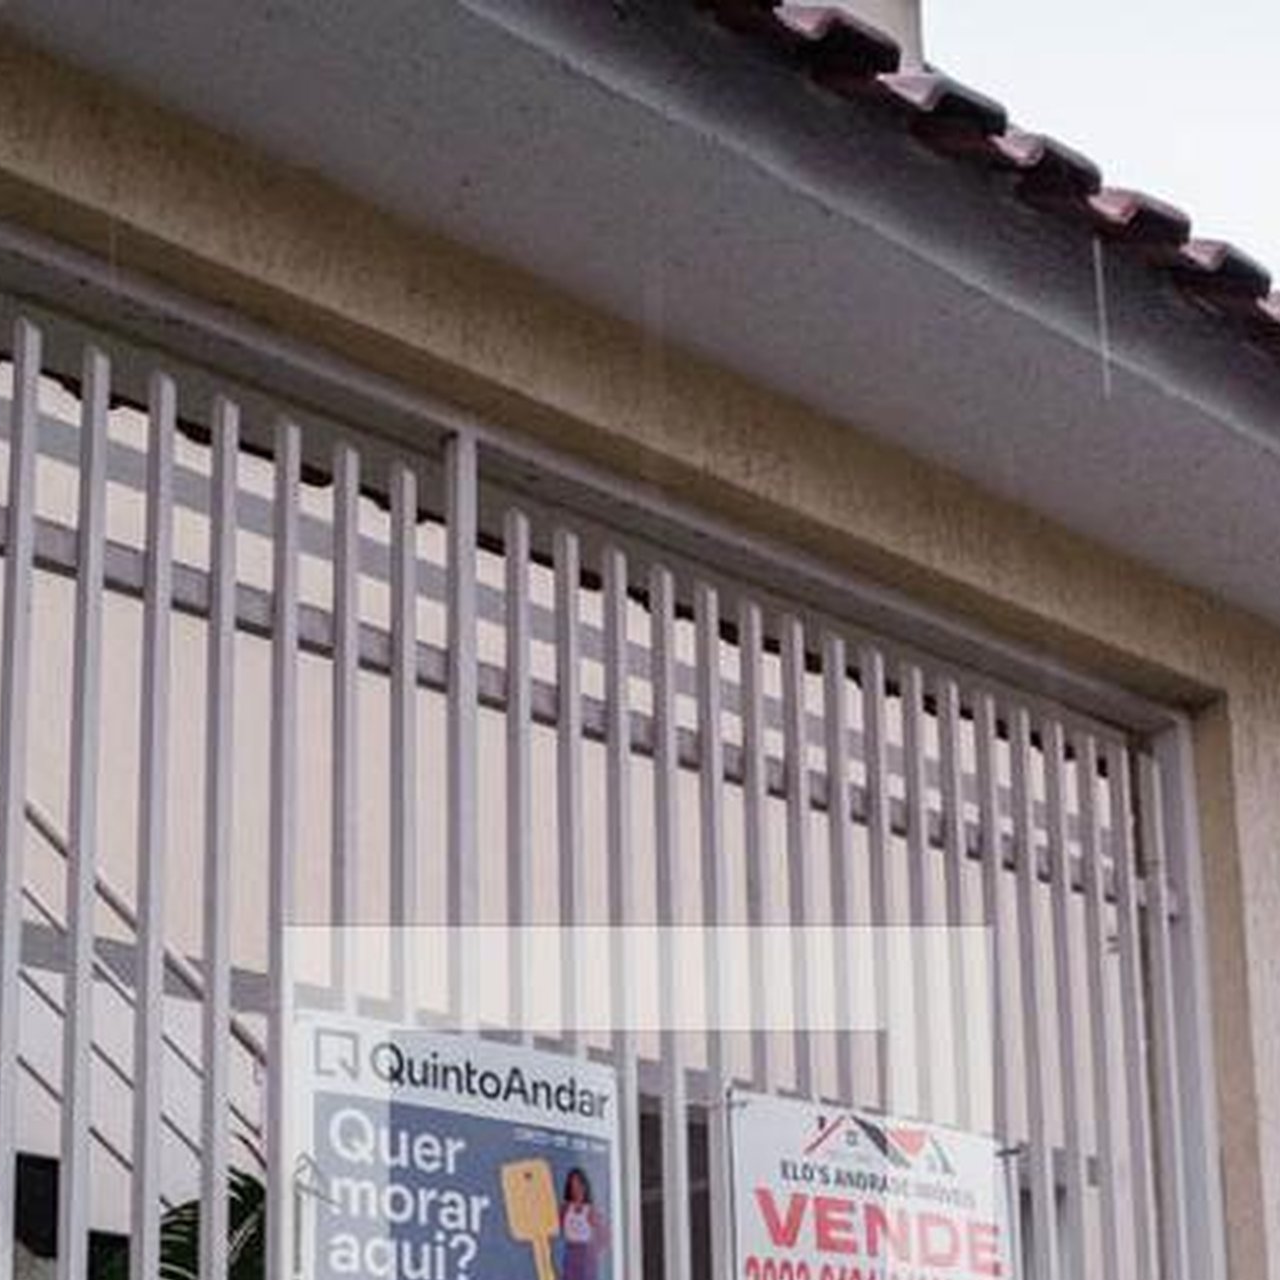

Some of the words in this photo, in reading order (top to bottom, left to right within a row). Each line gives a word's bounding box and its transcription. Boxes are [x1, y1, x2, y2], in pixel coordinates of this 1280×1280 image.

[370, 1041, 609, 1119] QuintoAndar
[328, 1107, 466, 1176] Quer
[330, 1174, 491, 1234] morar
[753, 1186, 1003, 1278] VENDE
